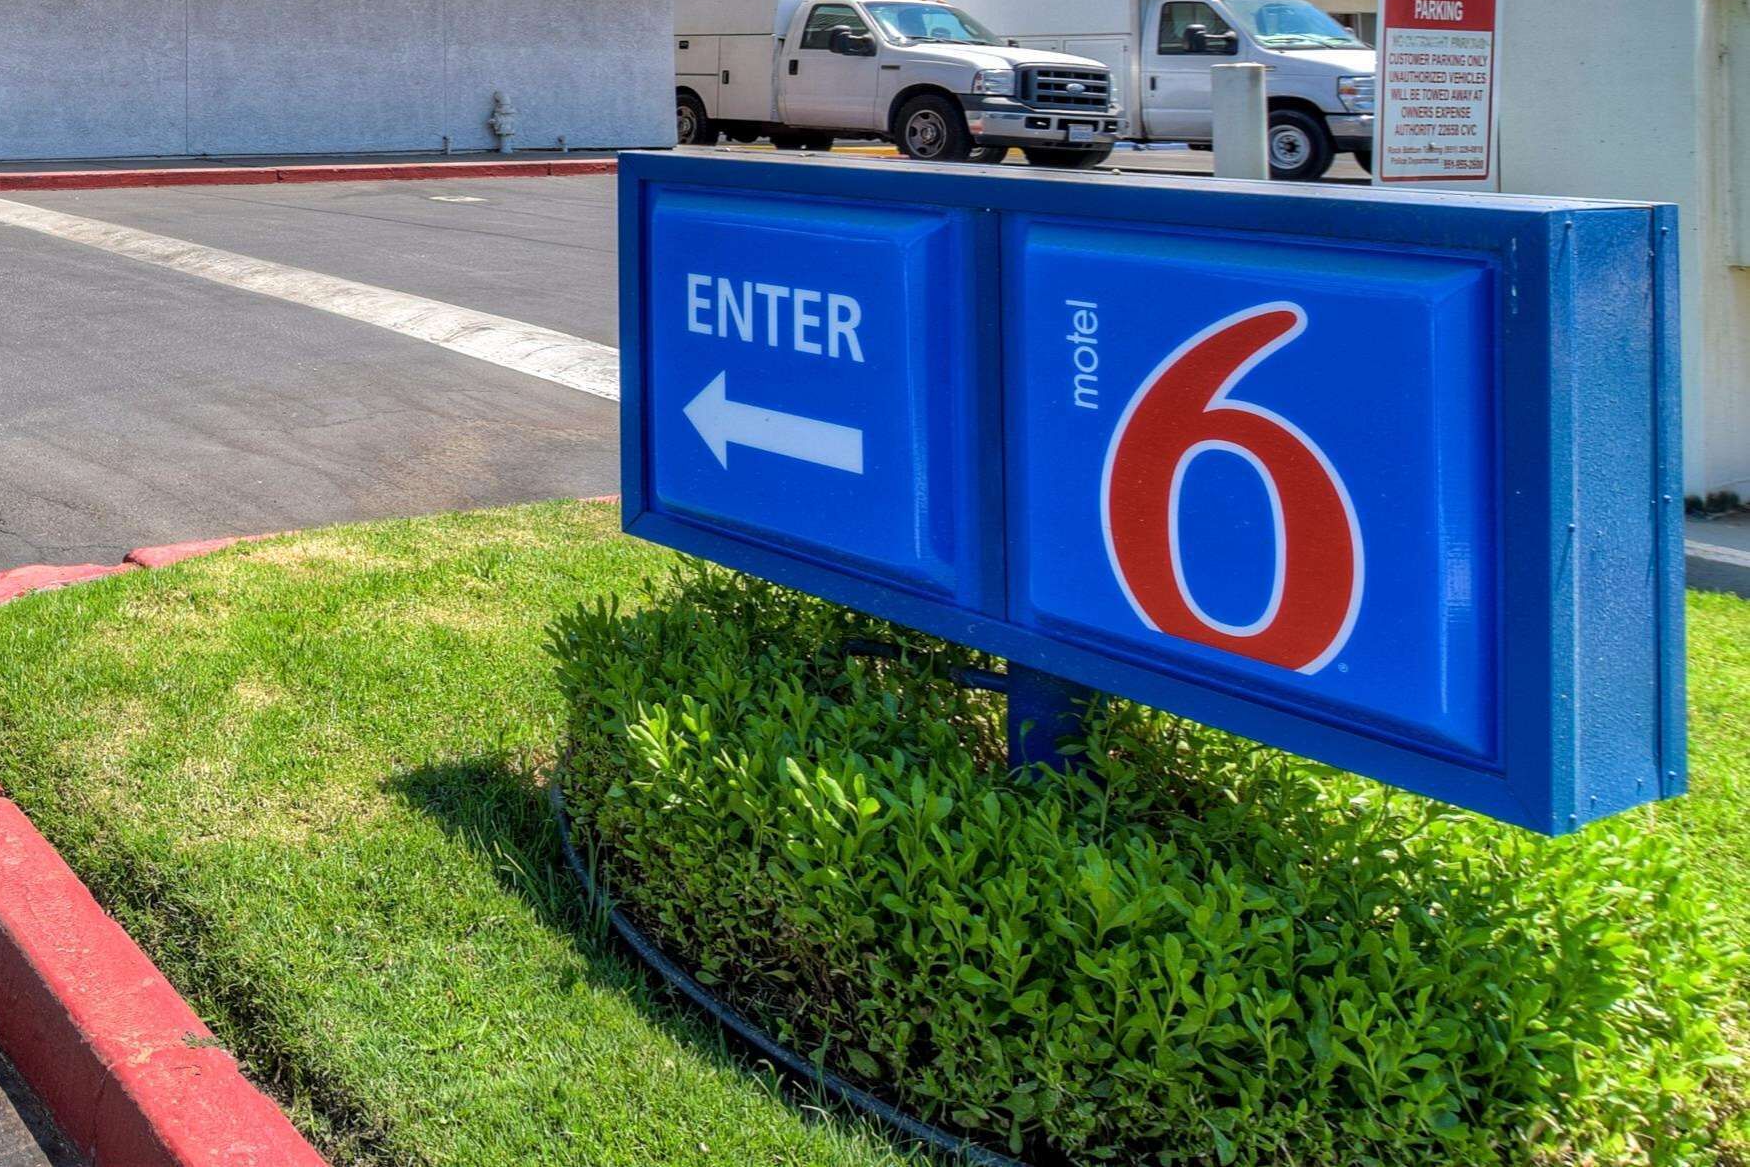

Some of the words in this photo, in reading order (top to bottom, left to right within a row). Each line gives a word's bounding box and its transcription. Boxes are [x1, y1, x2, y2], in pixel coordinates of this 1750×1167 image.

[1414, 0, 1464, 21] PARKING
[1389, 52, 1430, 65] CUSTOMER
[1431, 53, 1465, 66] PARKING
[1467, 55, 1489, 67] ONLY
[1389, 70, 1448, 83] UNAUTHORIZED
[1449, 72, 1487, 84] VEHICLES
[1390, 88, 1409, 100] WILL
[1410, 88, 1420, 100] BE
[1422, 88, 1450, 101] TOWED
[1473, 89, 1484, 101] AT
[1401, 106, 1434, 119] OWNERS
[1435, 106, 1472, 119] EXPENSE
[1395, 123, 1437, 136] AUTHORITY
[1460, 124, 1477, 136] CVC
[686, 272, 864, 363] ENTER
[1068, 299, 1101, 410] motel
[1100, 301, 1364, 675] 6
